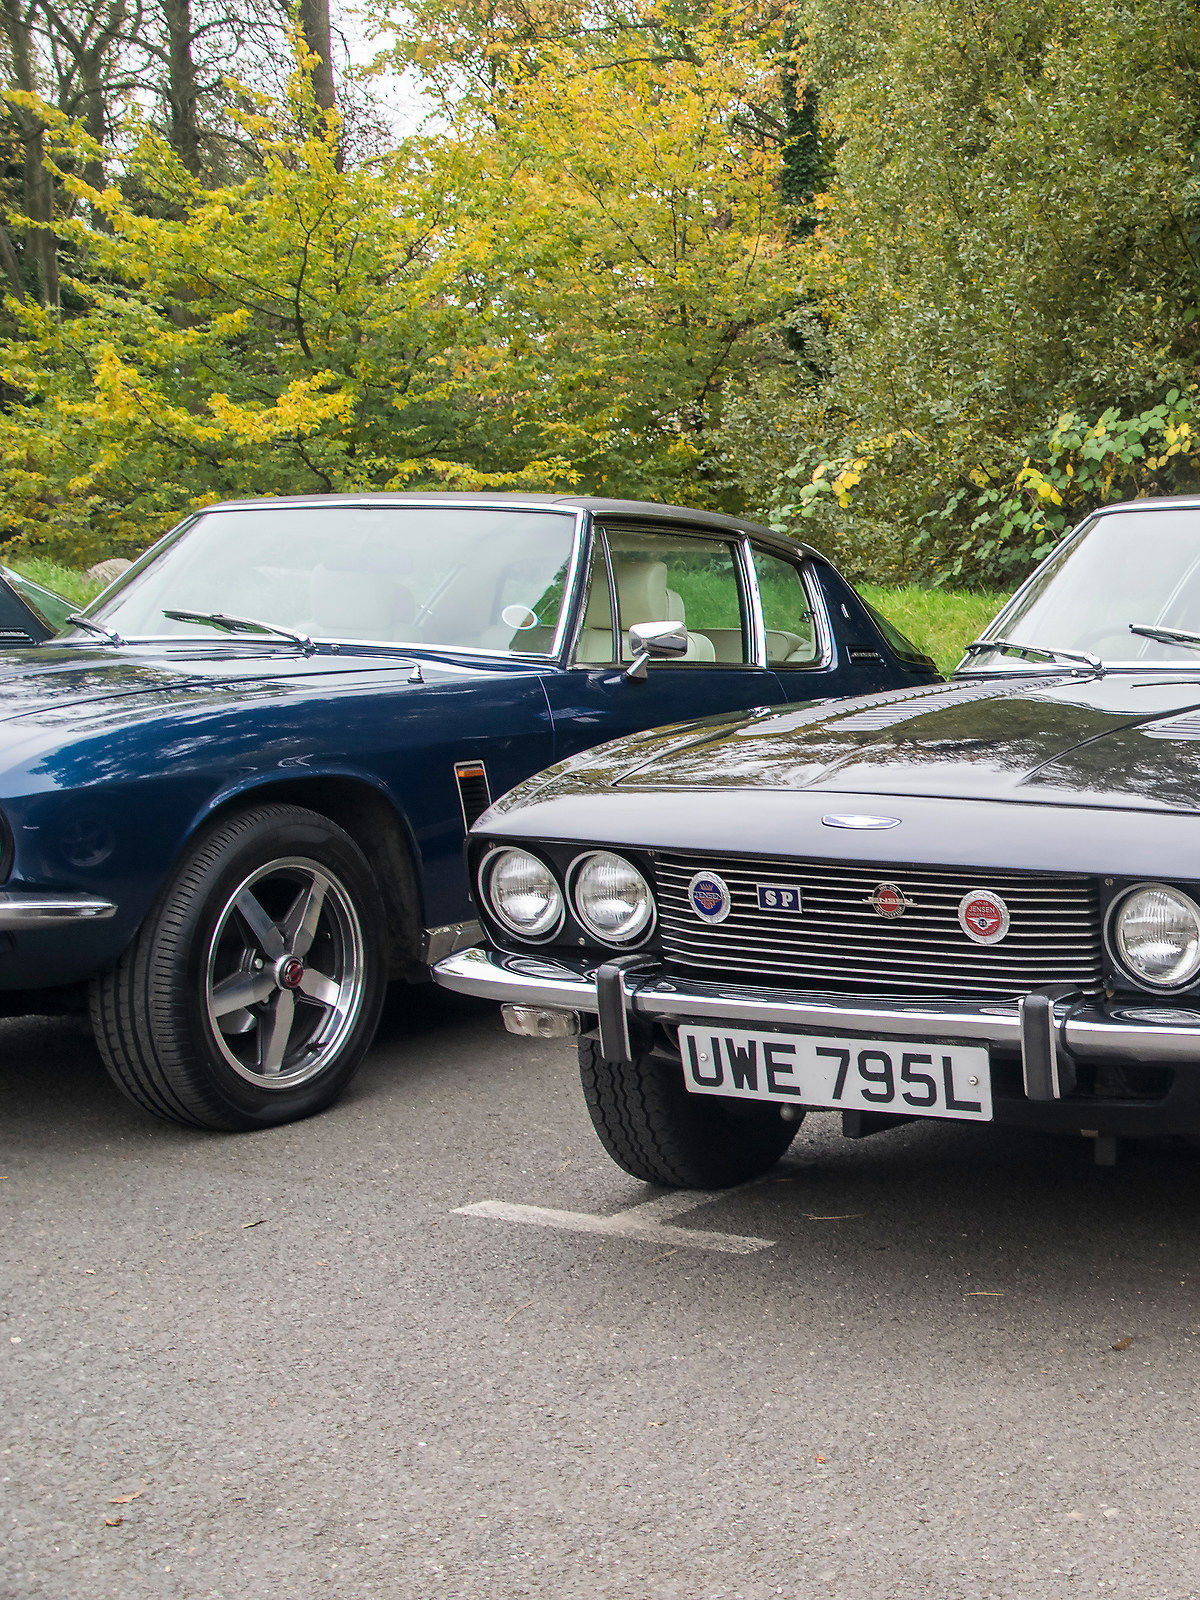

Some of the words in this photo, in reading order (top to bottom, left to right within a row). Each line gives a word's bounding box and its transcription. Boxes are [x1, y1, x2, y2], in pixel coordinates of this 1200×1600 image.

[969, 905, 996, 914] JENSEN
[686, 1034, 802, 1097] UWE
[815, 1045, 982, 1114] 795L
